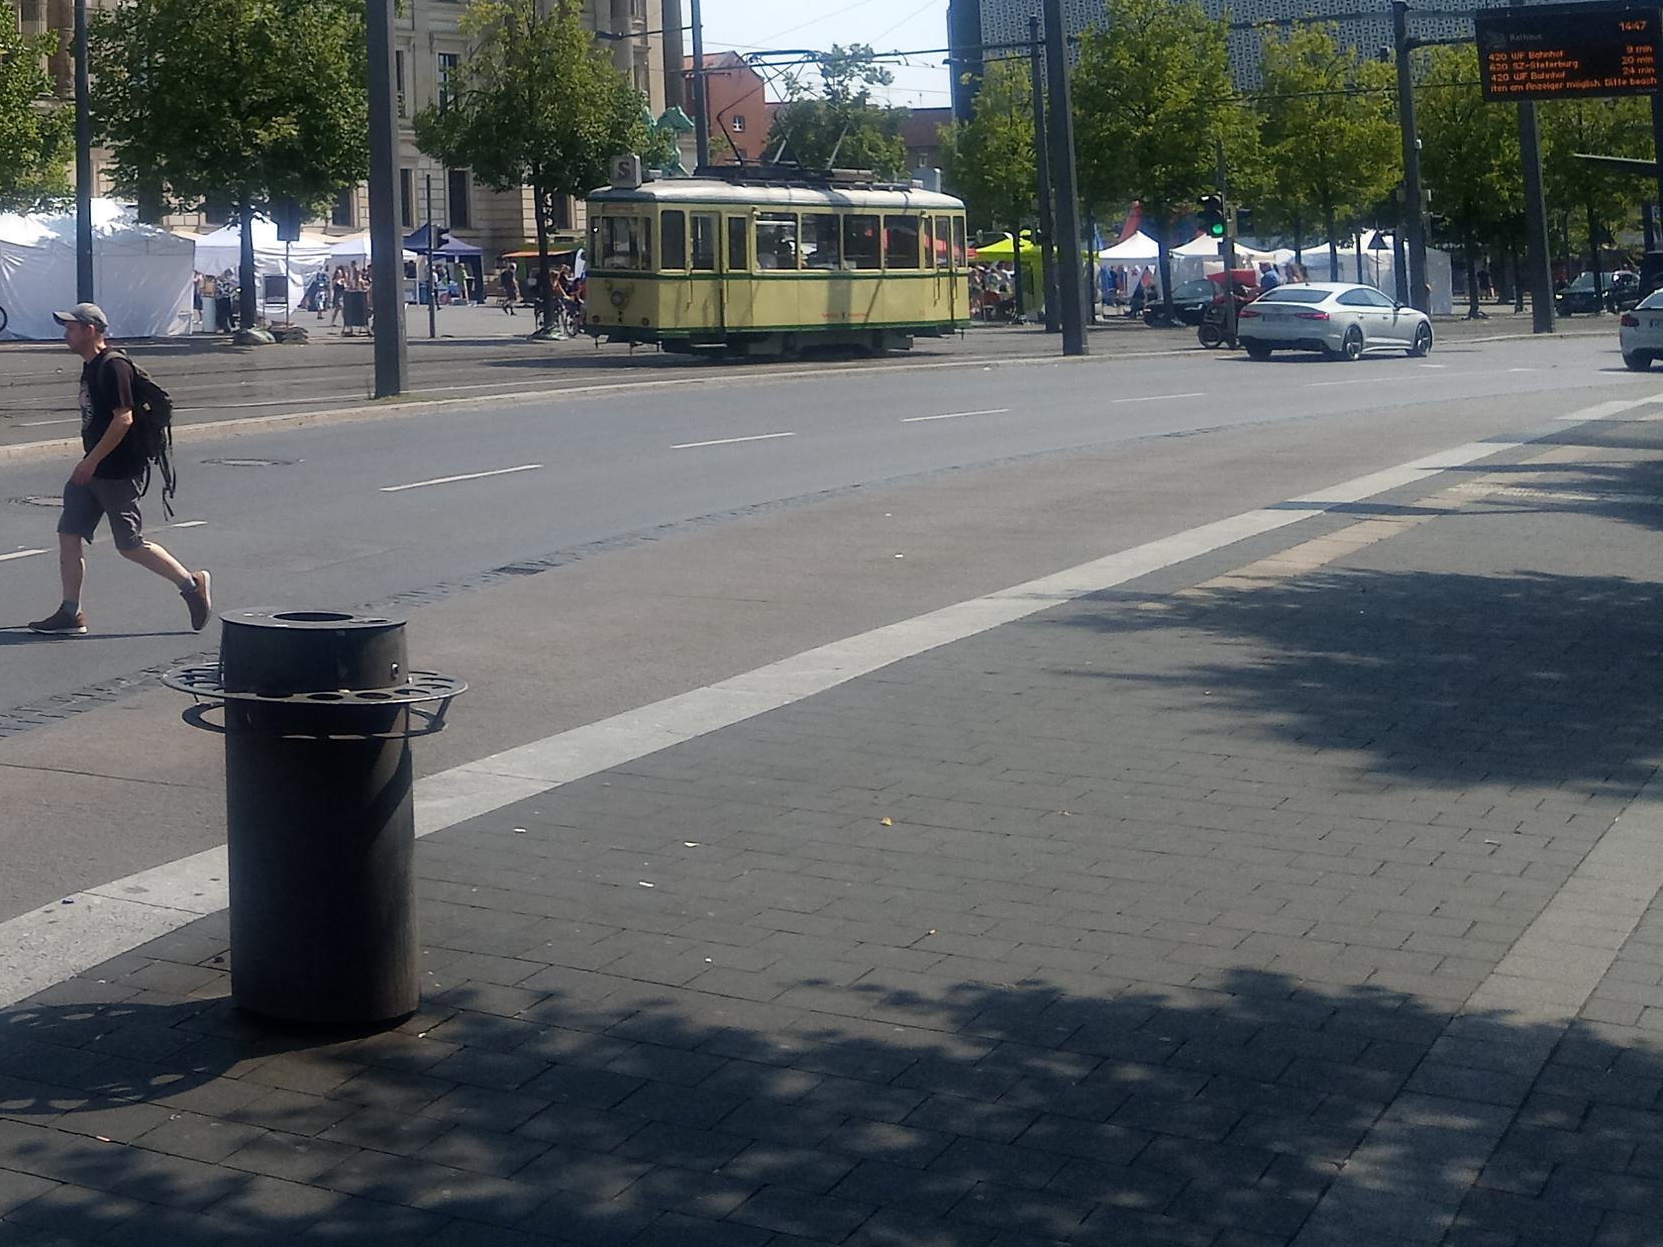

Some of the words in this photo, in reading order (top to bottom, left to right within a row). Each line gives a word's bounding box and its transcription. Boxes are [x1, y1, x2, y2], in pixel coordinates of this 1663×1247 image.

[1636, 44, 1653, 53] min
[1528, 50, 1563, 59] Bahnhof
[1636, 55, 1654, 64] min
[1638, 65, 1655, 74] min
[1531, 70, 1566, 80] Bahnhof
[1526, 81, 1563, 91] Anzeiger
[1604, 77, 1627, 87] Bitte
[618, 161, 630, 177] S
